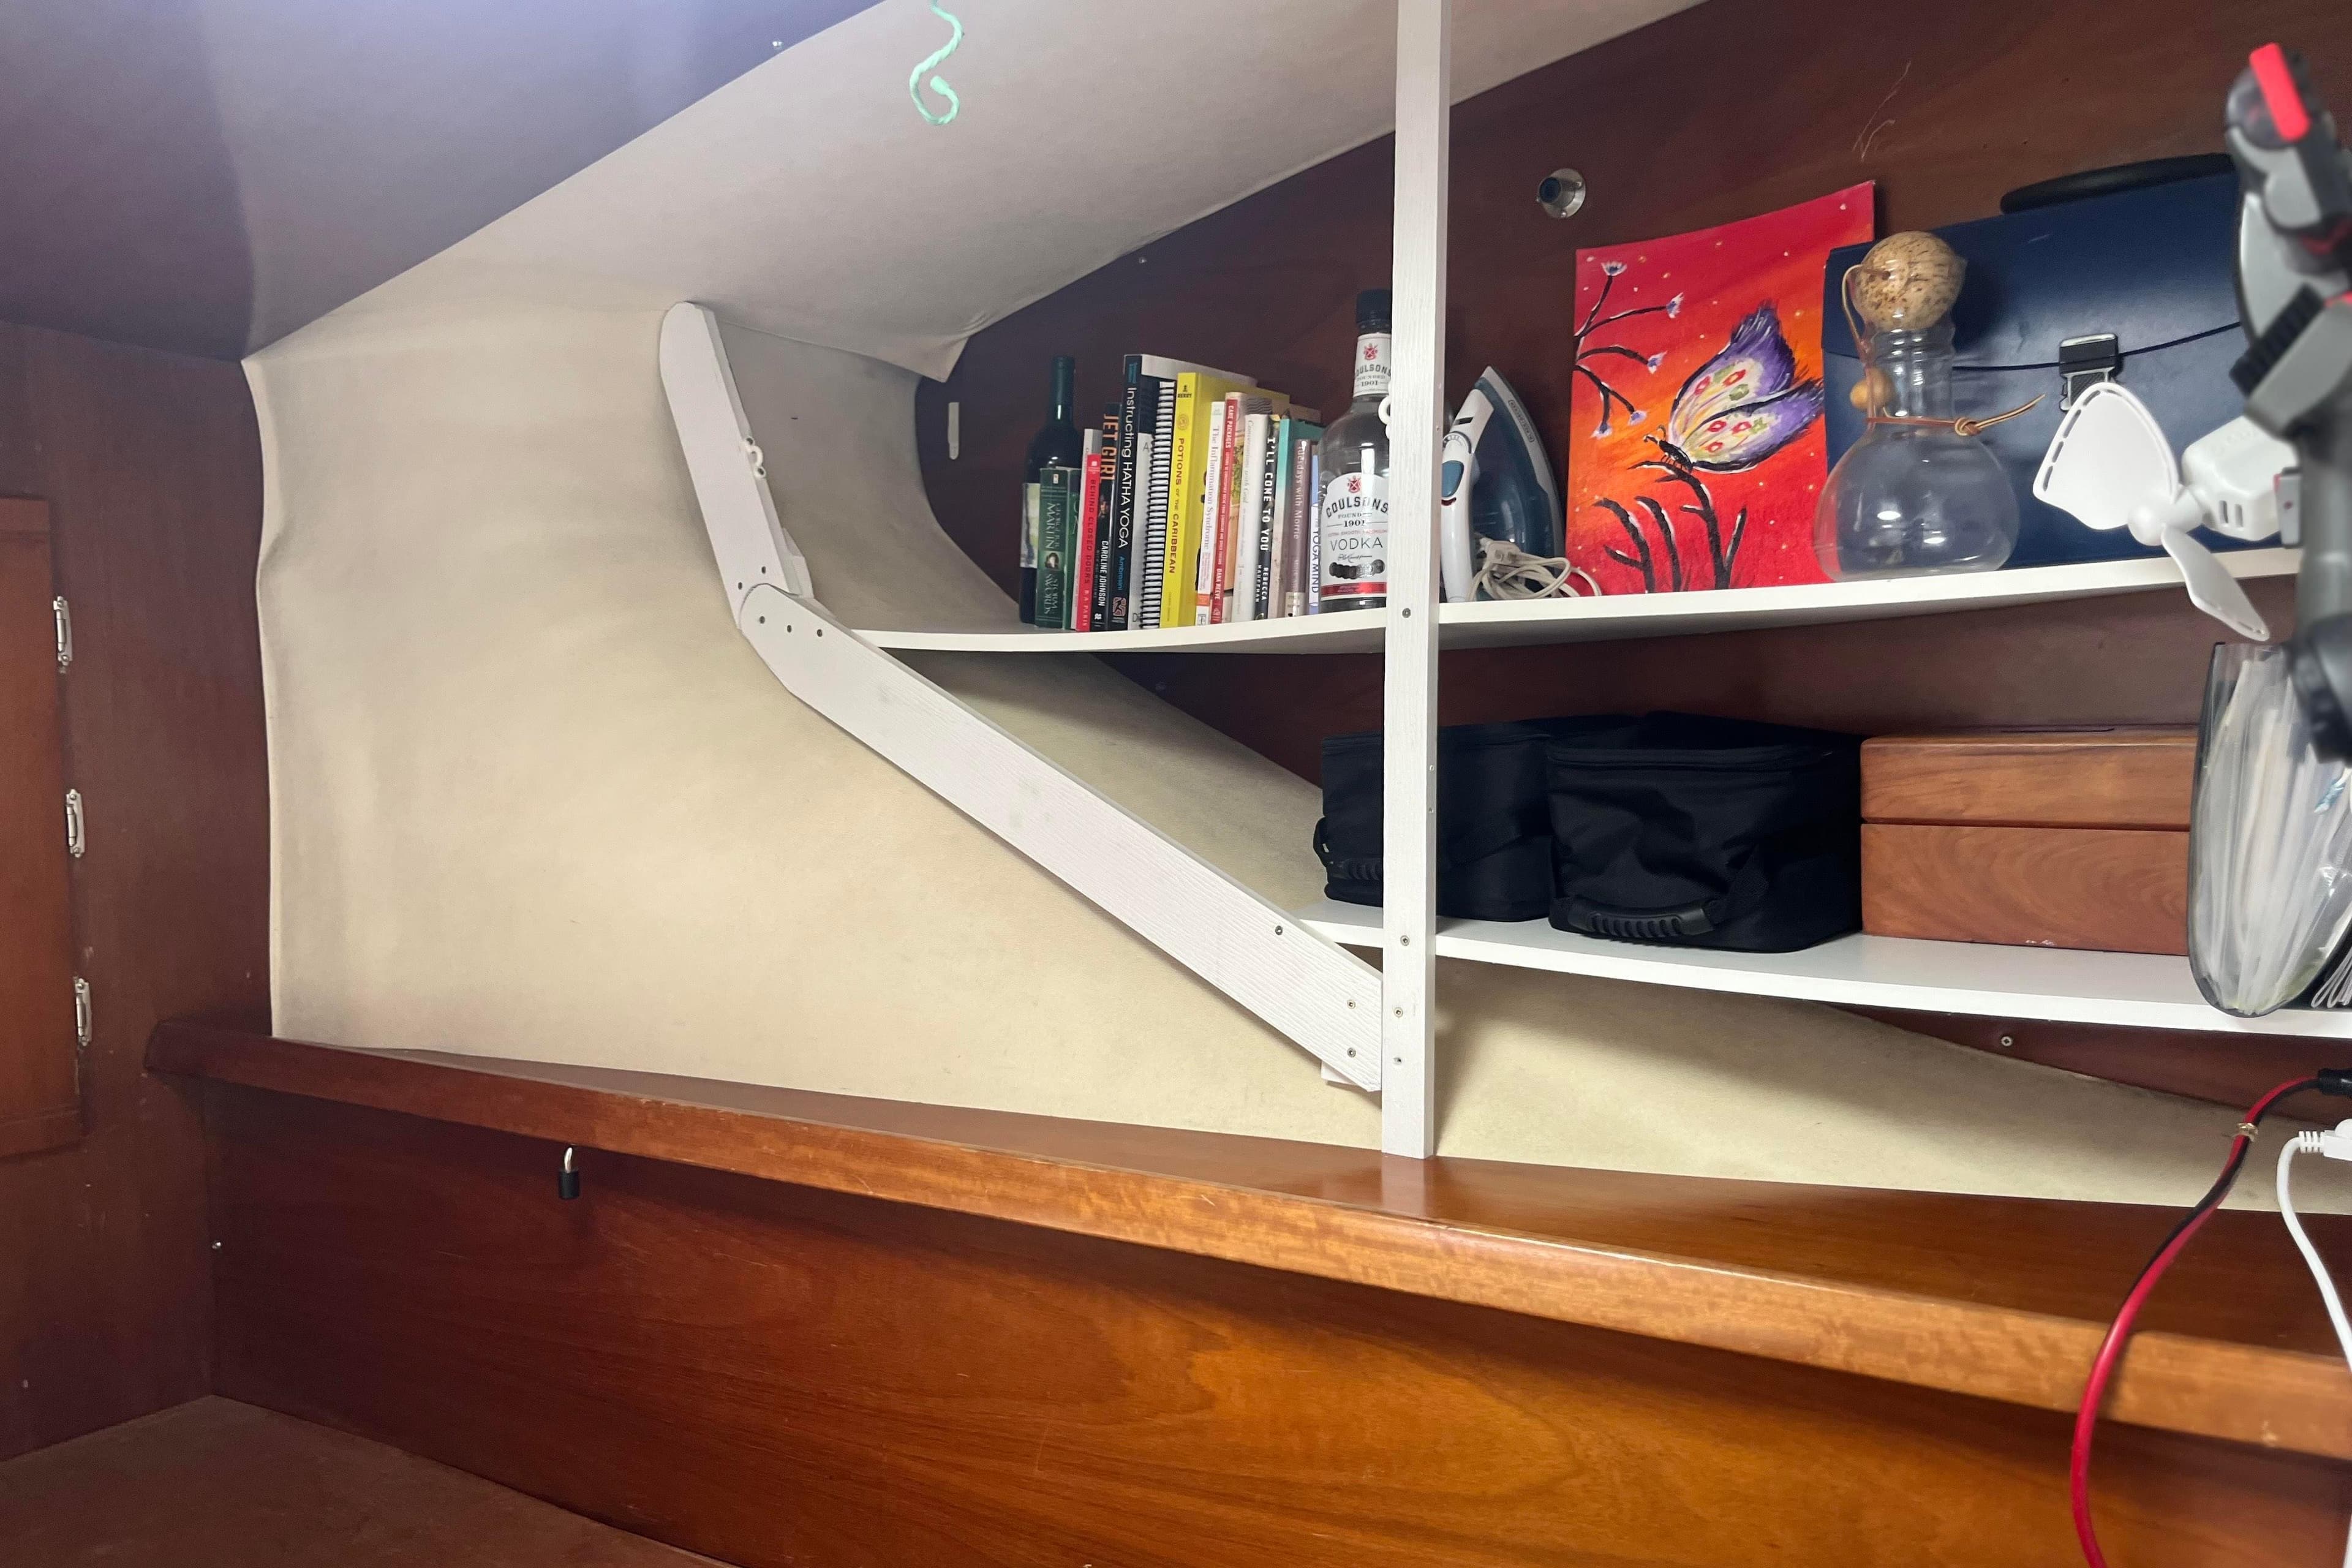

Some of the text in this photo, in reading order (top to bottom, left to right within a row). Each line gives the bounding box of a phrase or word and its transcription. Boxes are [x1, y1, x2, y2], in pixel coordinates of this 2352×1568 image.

[1356, 364, 1391, 377] OULSONS
[1121, 388, 1137, 458] Instructing
[1225, 421, 1234, 448] PACKAGES
[1100, 414, 1119, 482] JET GIRL
[1175, 438, 1185, 486] POTIONS
[1120, 462, 1132, 506] HATHA
[1260, 437, 1276, 551] I'LL COME TO YOU
[1294, 487, 1303, 507] with
[1045, 502, 1056, 549] MARTIN
[1087, 516, 1095, 552] CLOSED
[1118, 508, 1130, 548] YOGA
[1169, 513, 1179, 573] CARIBBEAN
[1204, 507, 1214, 550] Syndrome
[1293, 510, 1303, 540] Morrie
[1330, 537, 1383, 551] VODKA
[1084, 554, 1093, 584] DOORS
[1098, 541, 1109, 606] CAROLINE JOHNSON
[1117, 556, 1126, 590] Ambrosini
